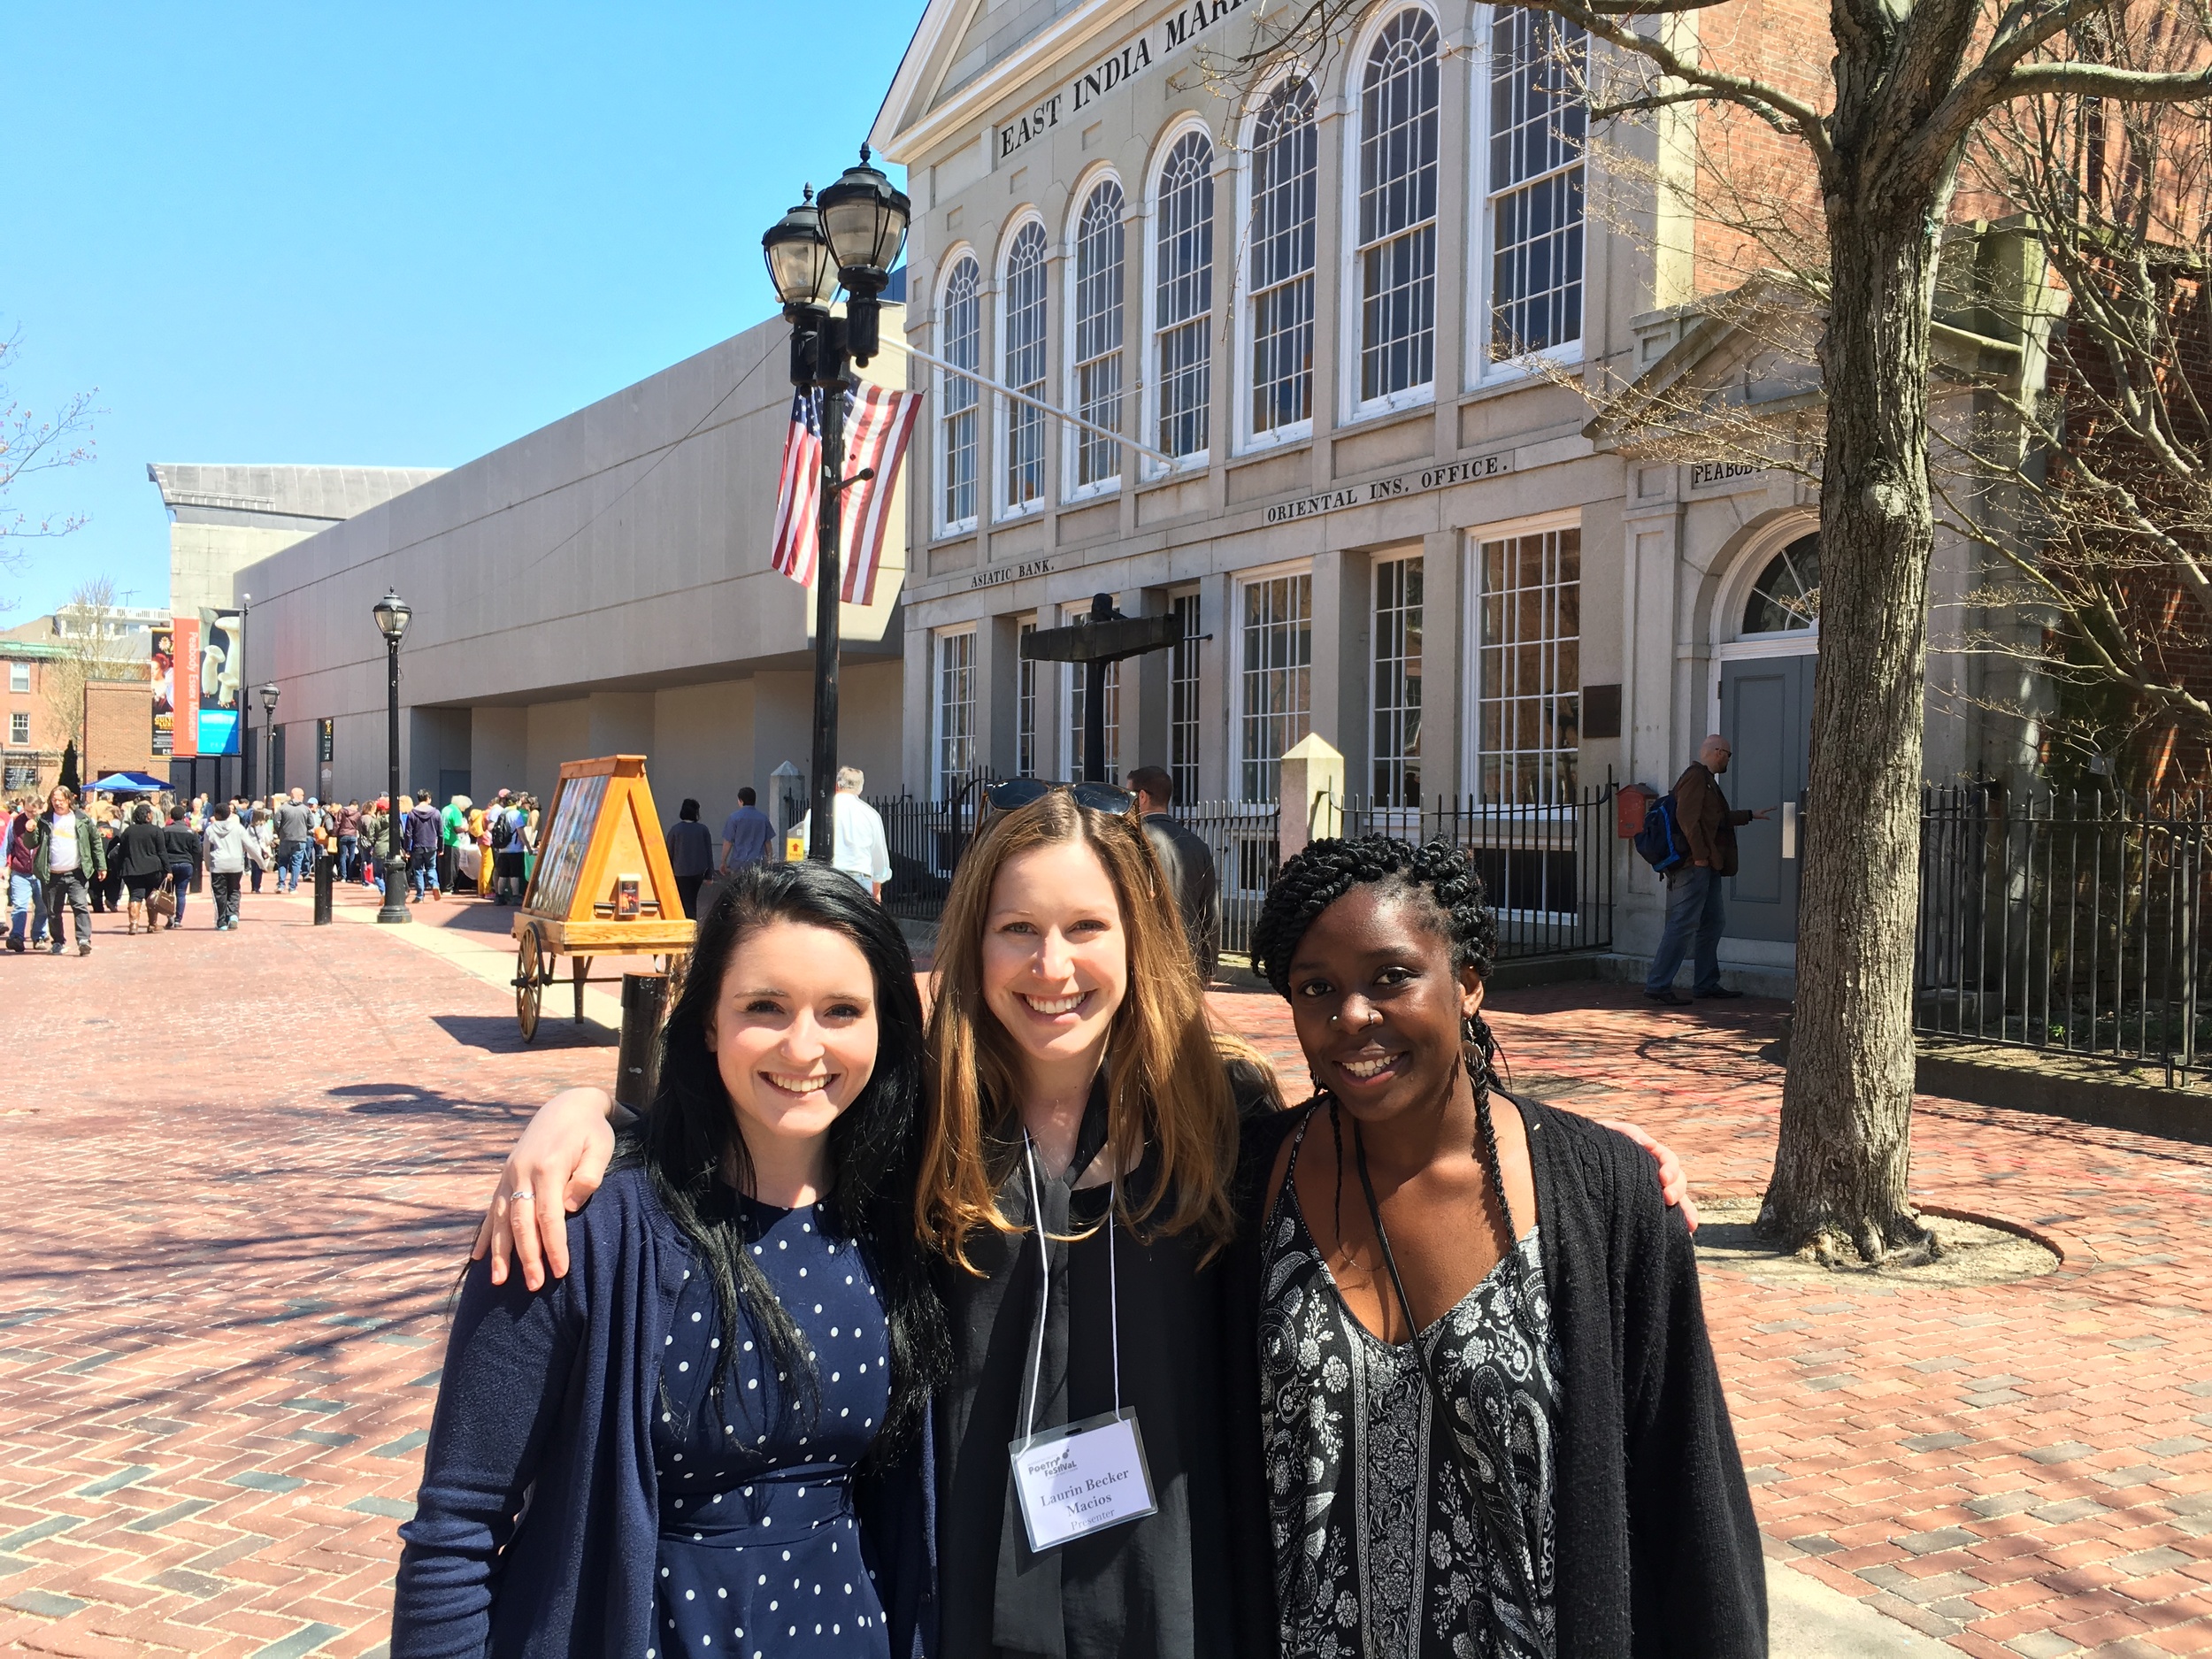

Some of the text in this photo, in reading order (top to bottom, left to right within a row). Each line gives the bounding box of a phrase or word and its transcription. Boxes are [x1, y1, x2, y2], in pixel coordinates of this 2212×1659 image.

[1001, 0, 1248, 158] EAST INDIA MAR
[1694, 461, 1762, 483] PEABOD
[1267, 457, 1509, 522] ORIENTAL INS. OFFICE.
[971, 559, 1055, 588] ASIATIC BANK.
[186, 631, 199, 741] Peabody Essex Museum
[1040, 1486, 1083, 1508] Laurin
[1085, 1469, 1130, 1492] Becker
[1066, 1493, 1112, 1517] Macios
[1070, 1509, 1115, 1531] Presenter
